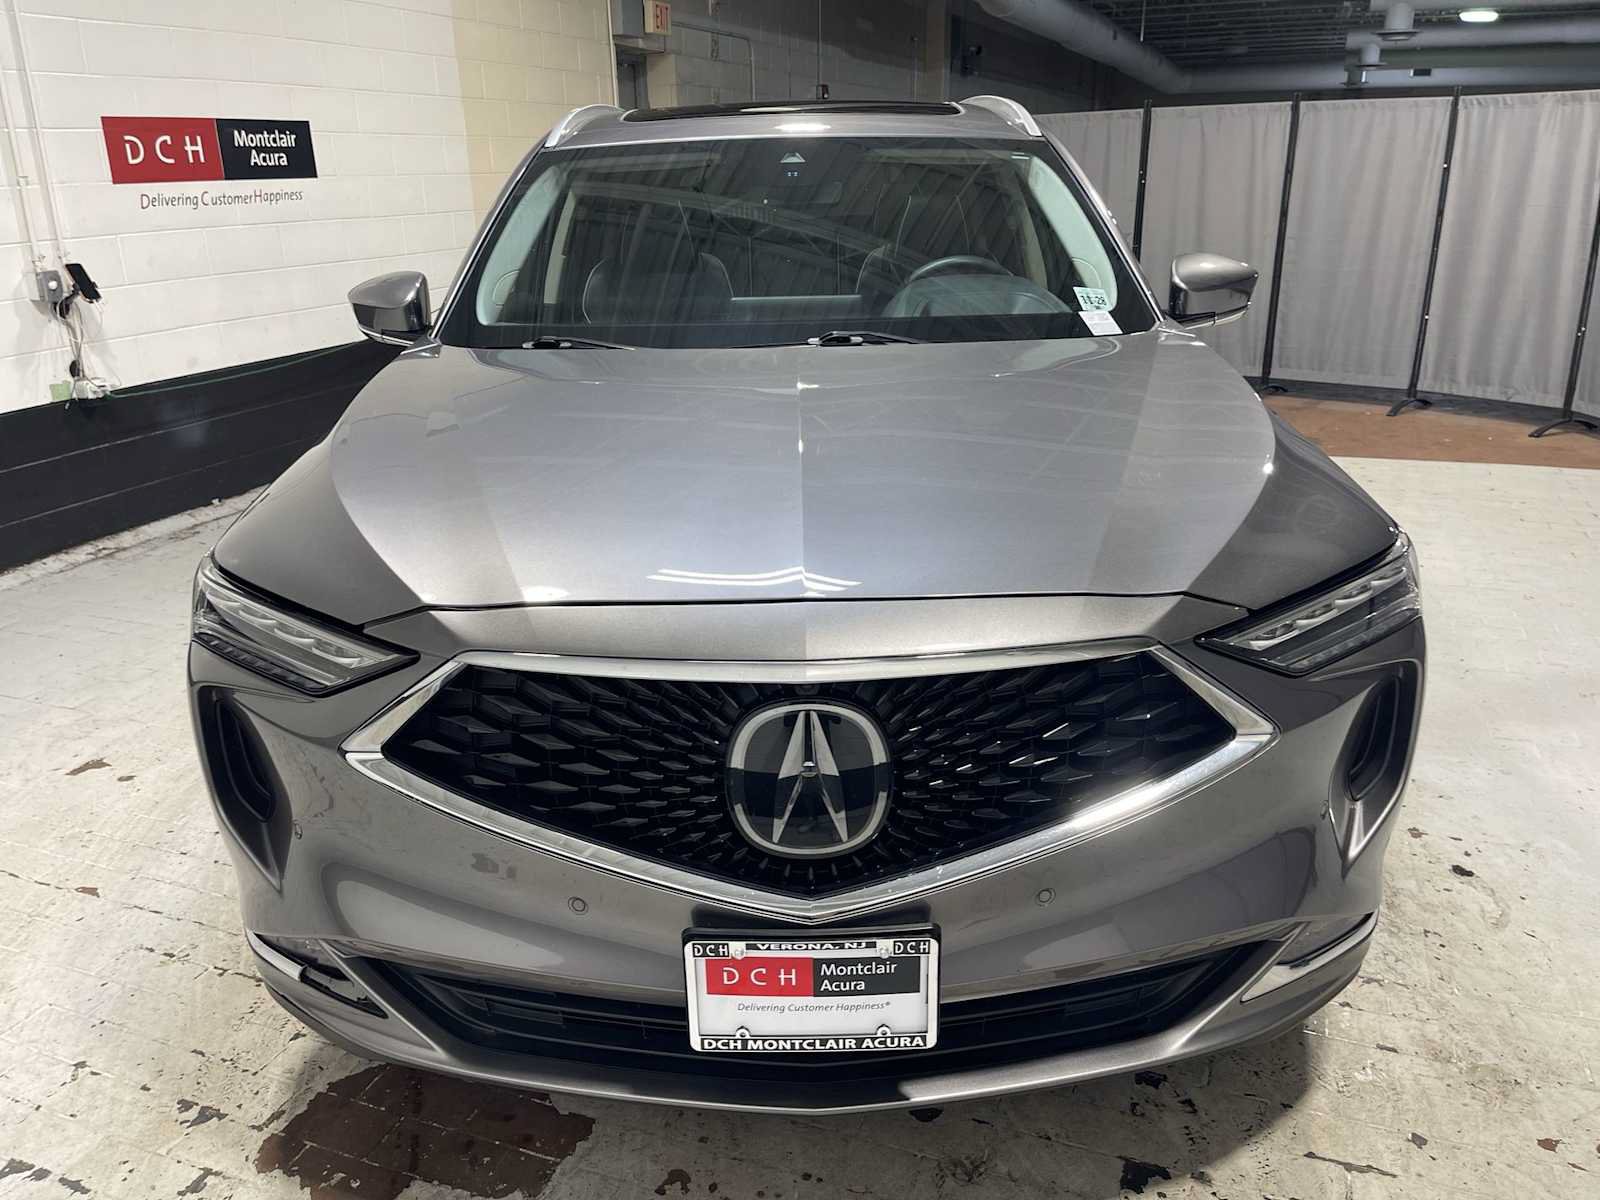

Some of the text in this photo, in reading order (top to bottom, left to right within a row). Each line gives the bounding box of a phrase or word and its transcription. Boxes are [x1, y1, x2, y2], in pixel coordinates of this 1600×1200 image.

[233, 129, 297, 148] Montclair
[122, 134, 206, 165] DCH
[250, 149, 288, 167] Acura
[140, 192, 199, 210] Delivering
[693, 944, 729, 957] DCH
[894, 941, 930, 954] DCH
[820, 961, 898, 976] Montclair
[722, 967, 797, 986] DCH
[819, 979, 866, 992] Acura
[737, 1003, 786, 1014] Delivering
[787, 1003, 834, 1013] Customer
[703, 1036, 925, 1051] DCH MONTCLAIR ACURA
